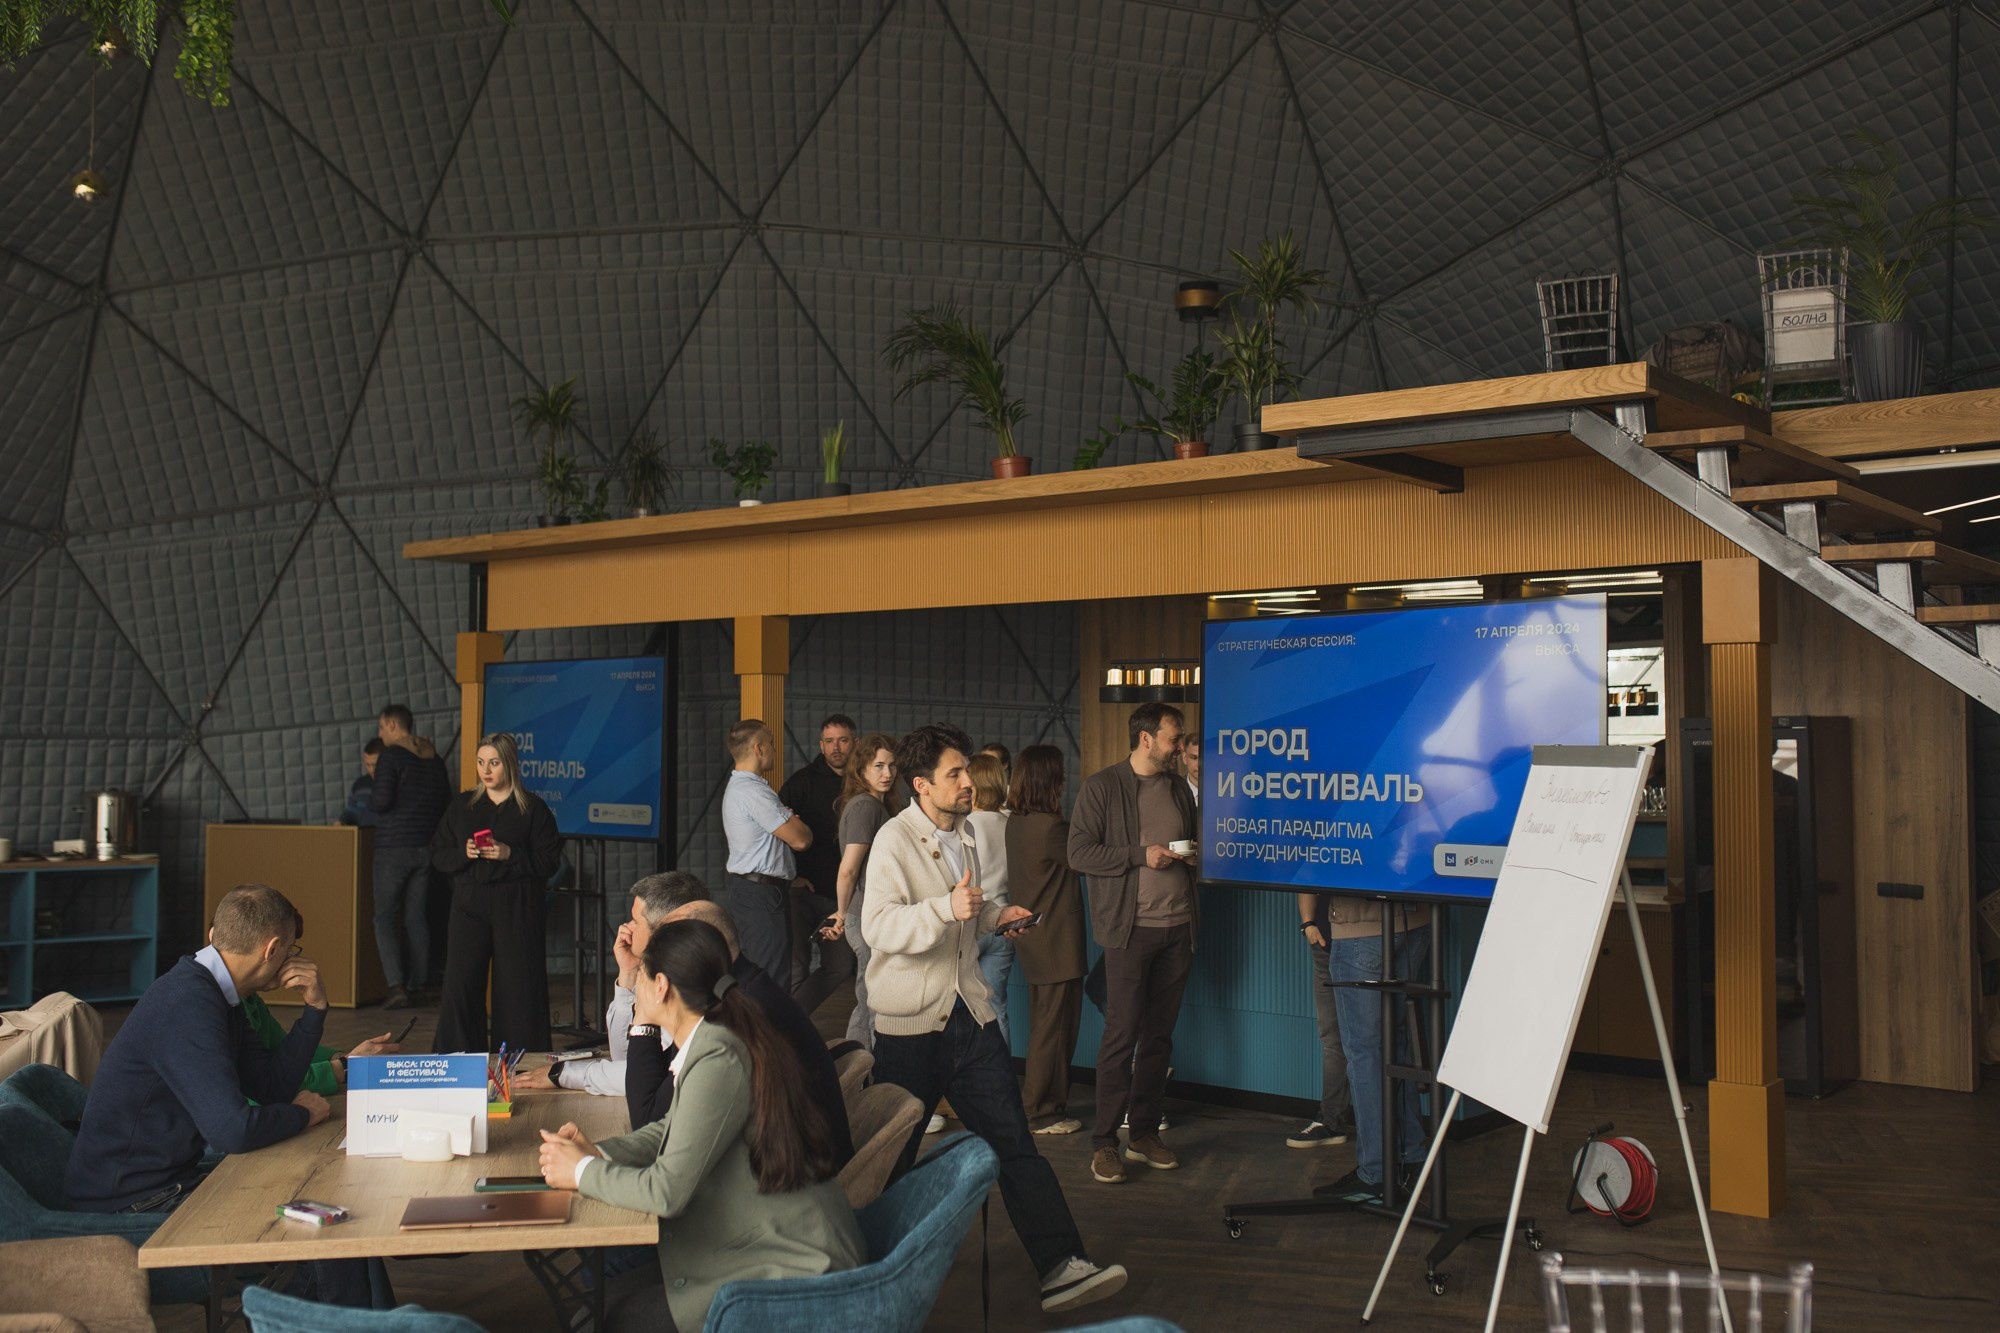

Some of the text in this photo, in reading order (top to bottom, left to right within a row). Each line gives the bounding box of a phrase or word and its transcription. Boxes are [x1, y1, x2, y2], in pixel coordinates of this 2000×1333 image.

[1475, 622, 1581, 639] 17 АПРЕЛЯ 2024
[1217, 634, 1356, 652] СТРАТЕГИЧЕСКАЯ СЕССИЯ:
[1535, 643, 1581, 657] ВЫКСА
[1217, 728, 1310, 762] ГОРОД
[1217, 771, 1424, 803] И ФЕСТИВАЛЬ
[1216, 817, 1373, 841] НОВАЯ ПАРАДИГМА
[1216, 842, 1363, 866] СОТРУДНИЧЕСТВА
[386, 1060, 449, 1069] ВЫКСА: ГОРОД
[396, 1069, 447, 1077] ФЕСТИВАЛЬ
